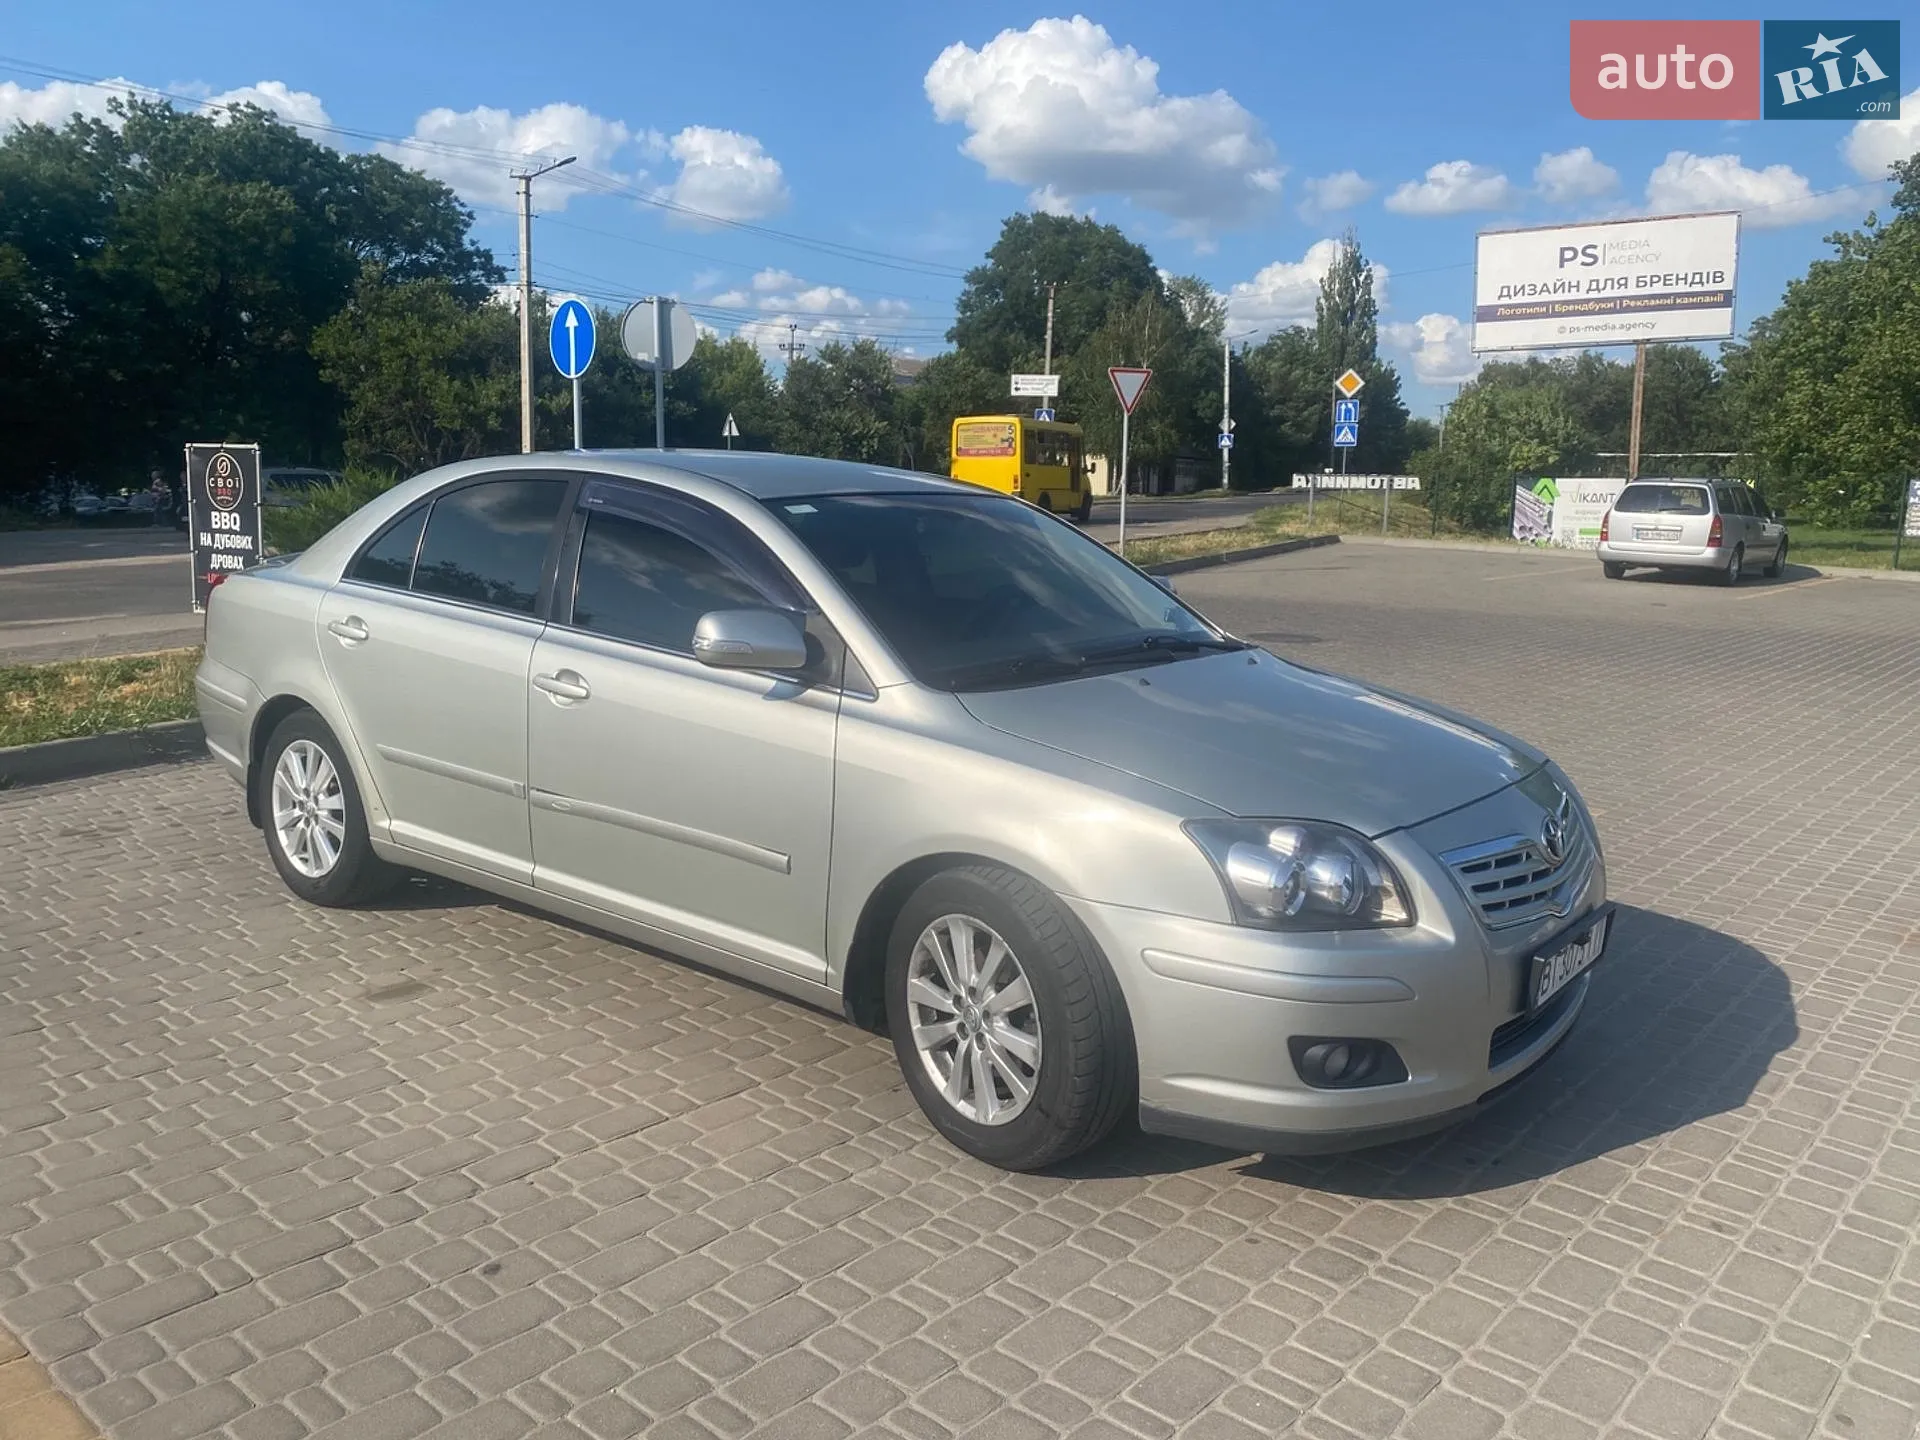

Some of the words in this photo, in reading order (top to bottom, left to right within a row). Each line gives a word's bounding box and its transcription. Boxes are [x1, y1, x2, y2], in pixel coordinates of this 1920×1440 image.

[1609, 239, 1651, 251] MEDIA
[1558, 244, 1600, 269] PS
[1609, 252, 1662, 266] AGENCY
[1497, 278, 1581, 301] ДИЗАЙН
[1586, 276, 1629, 295] ДЛЯ
[1635, 270, 1726, 289] БРЕНДІВ
[1497, 304, 1547, 317] Логотипи
[1554, 300, 1615, 314] Брендбуки
[1622, 296, 1674, 309] Рекламні
[1676, 293, 1724, 305] кампанії
[1569, 320, 1657, 335] ps-media.agency
[1570, 482, 1617, 504] VIKANT
[211, 511, 241, 532] BBQ
[200, 532, 213, 546] НА
[213, 533, 253, 550] ДУБОВИХ
[210, 553, 244, 570] ДРОВАХ
